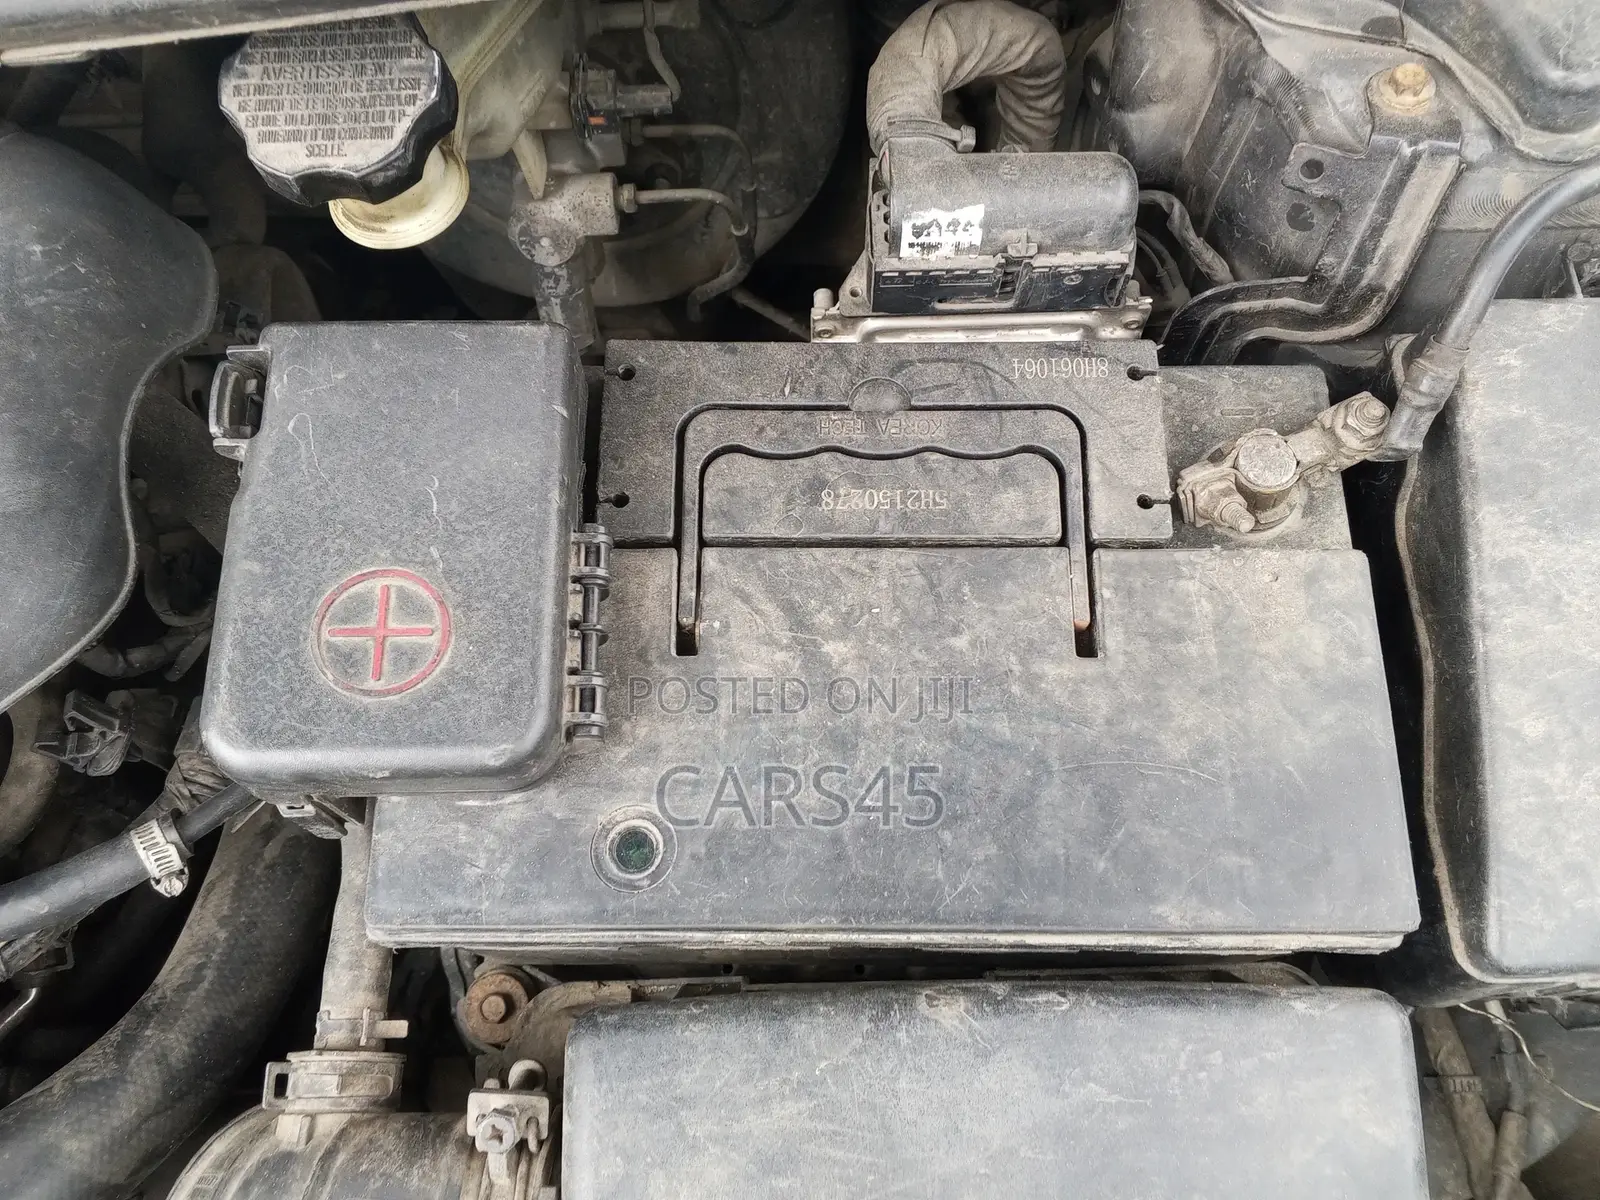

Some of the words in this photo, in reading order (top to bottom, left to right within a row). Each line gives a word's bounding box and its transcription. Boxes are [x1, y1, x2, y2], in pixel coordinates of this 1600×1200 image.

[1012, 357, 1110, 379] 8H061064
[819, 417, 867, 436] TECH
[876, 417, 943, 436] KOREA
[821, 488, 949, 511] 5H2150278
